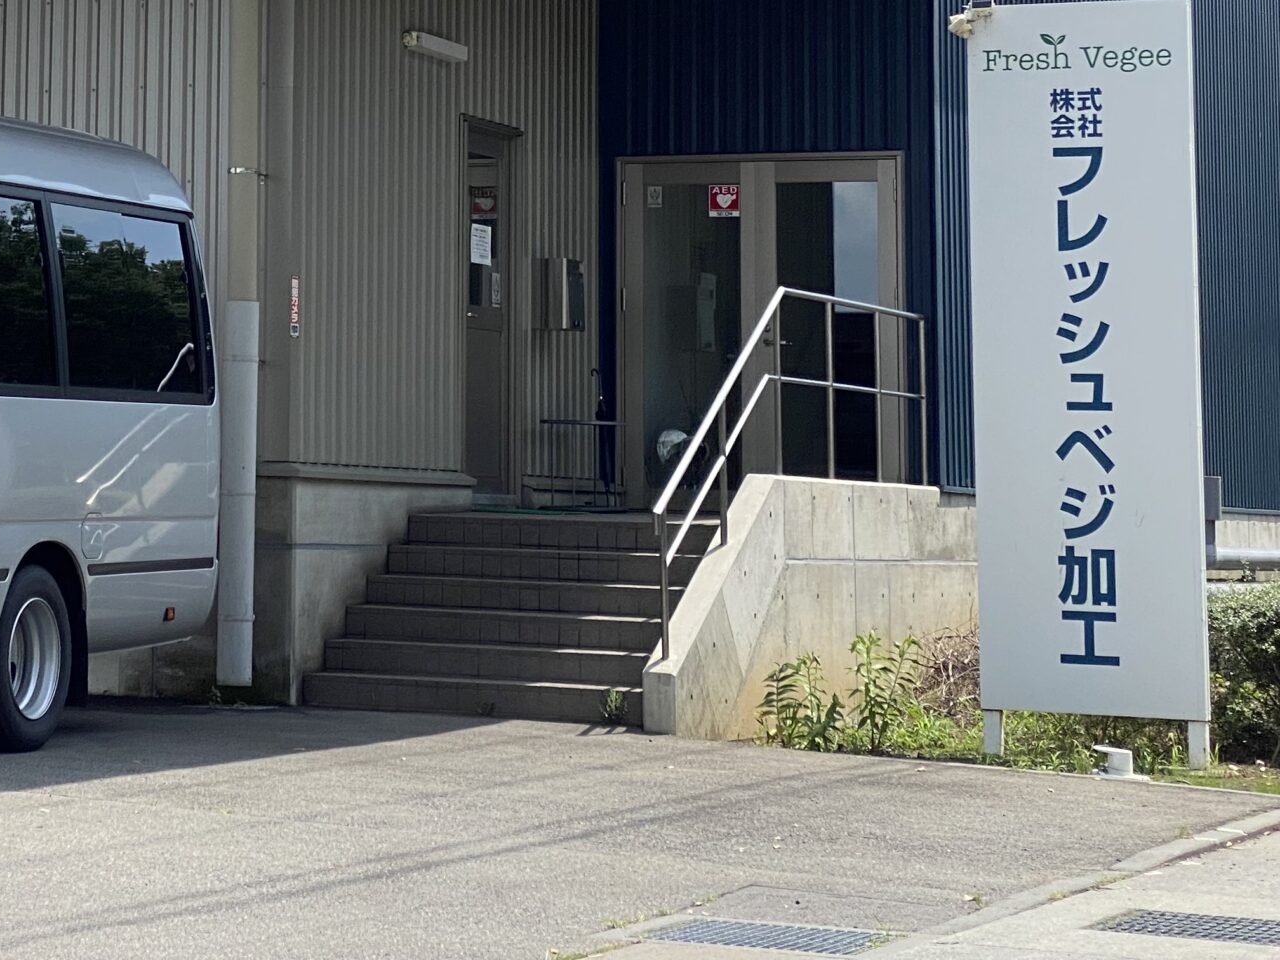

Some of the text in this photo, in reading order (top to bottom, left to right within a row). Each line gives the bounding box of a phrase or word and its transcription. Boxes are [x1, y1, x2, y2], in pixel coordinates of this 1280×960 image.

[982, 43, 1172, 73] Fresh Vegee
[712, 186, 738, 194] AED
[1051, 146, 1121, 667] フレッシュベジ加工
